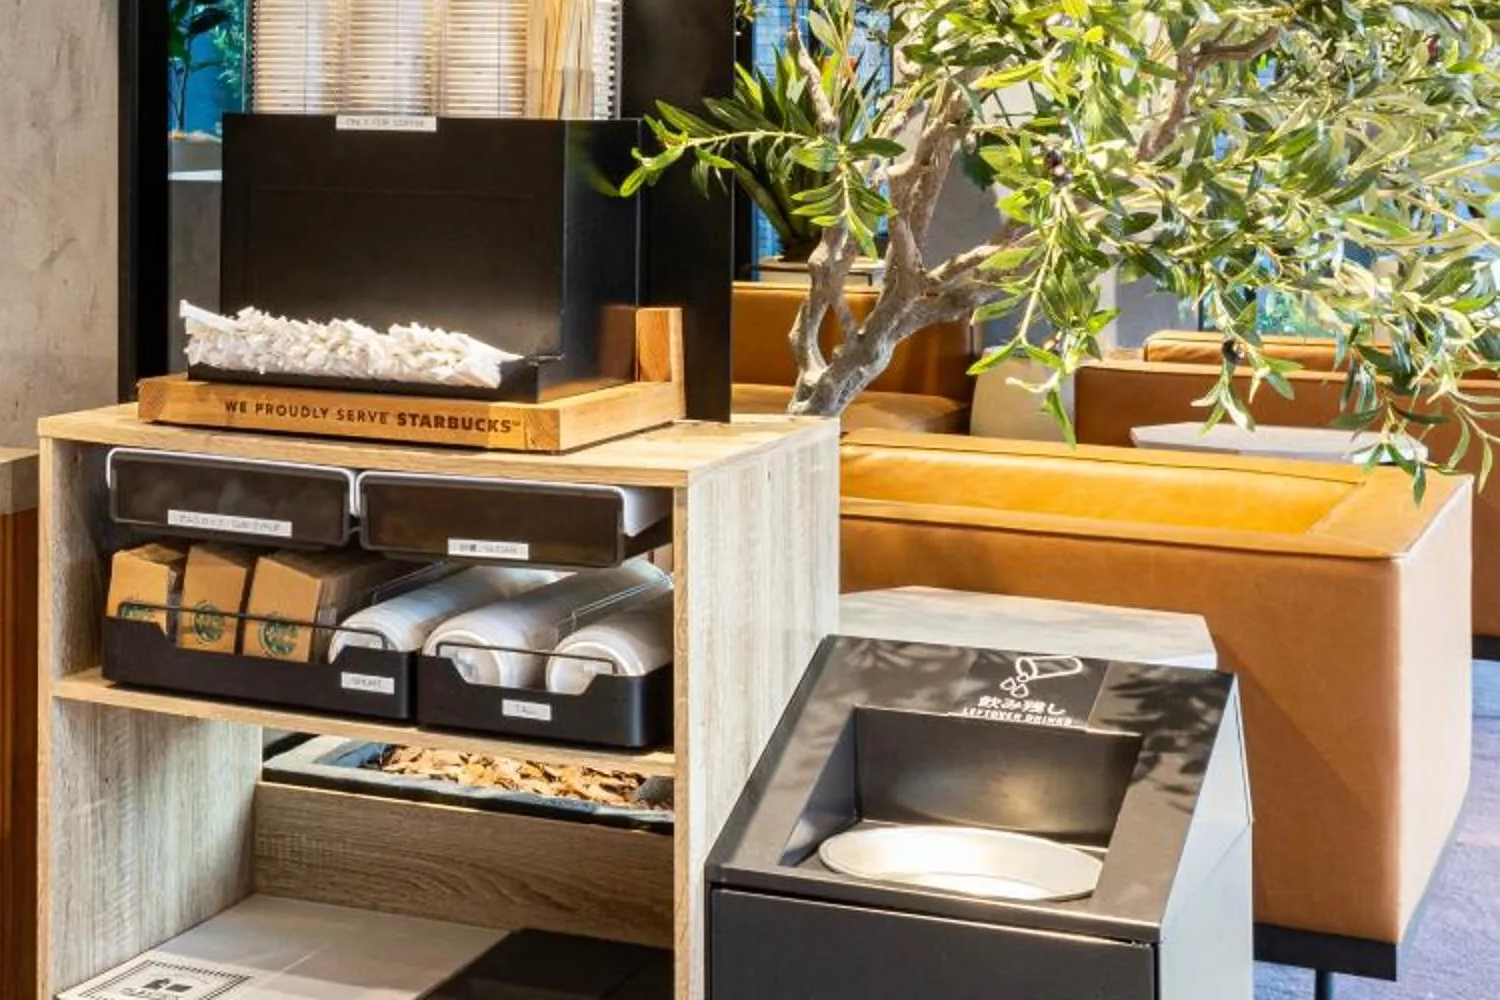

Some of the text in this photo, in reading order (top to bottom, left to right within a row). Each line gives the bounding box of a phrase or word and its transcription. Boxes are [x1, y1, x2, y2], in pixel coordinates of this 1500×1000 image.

[224, 400, 247, 414] WE
[255, 402, 329, 420] PROUDLY
[336, 408, 390, 426] SERVE
[963, 707, 1021, 721] LEFTOVER
